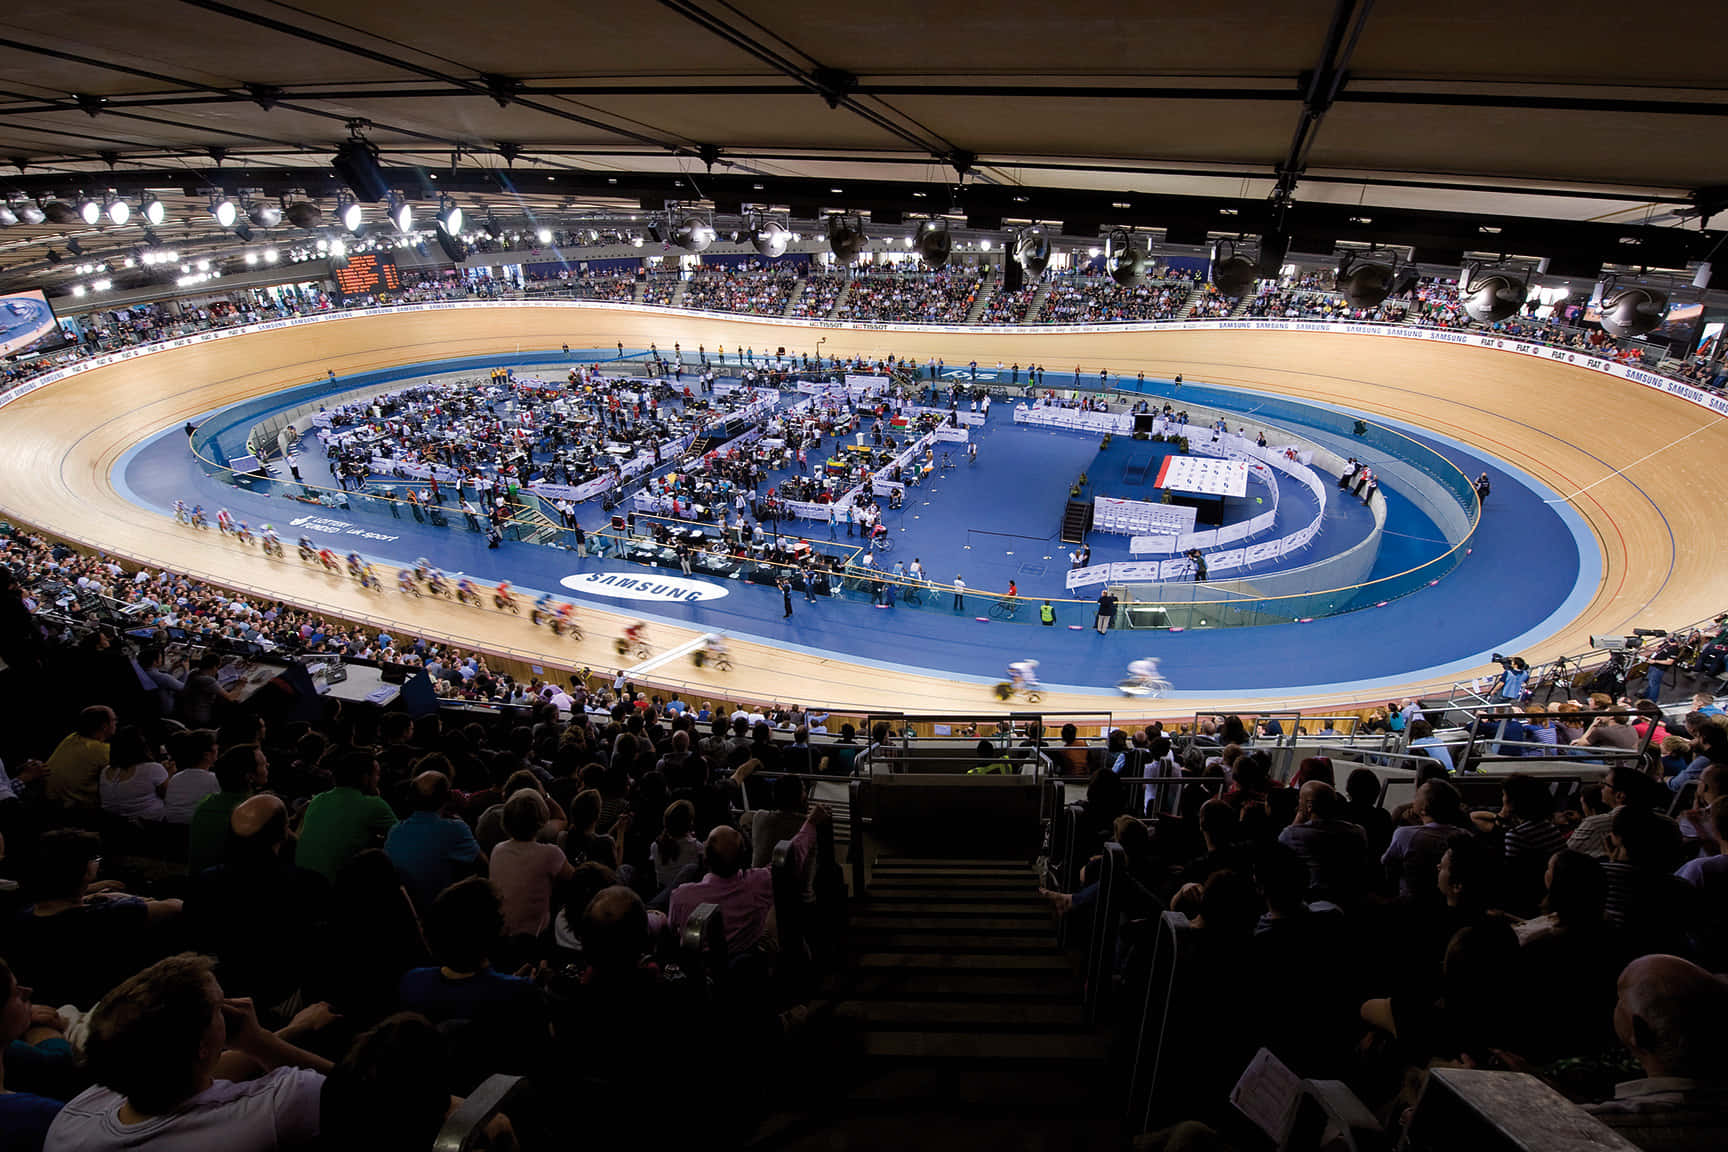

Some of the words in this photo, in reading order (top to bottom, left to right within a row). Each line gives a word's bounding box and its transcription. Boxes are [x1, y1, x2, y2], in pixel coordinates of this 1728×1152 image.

[1296, 323, 1331, 331] SAMSUNG
[1346, 325, 1382, 334] SAMSUNG
[1387, 328, 1423, 338] SAMSUNG
[1430, 332, 1468, 343] SAMSUNG
[1480, 338, 1495, 347] FIAT
[1516, 344, 1531, 353] FIAT
[1551, 351, 1566, 360] FIAT
[1587, 359, 1602, 369] FIAT
[1625, 368, 1664, 388] SAMSUNG
[1667, 382, 1704, 403] SAMSUNG
[586, 572, 703, 602] SAMSUNG
